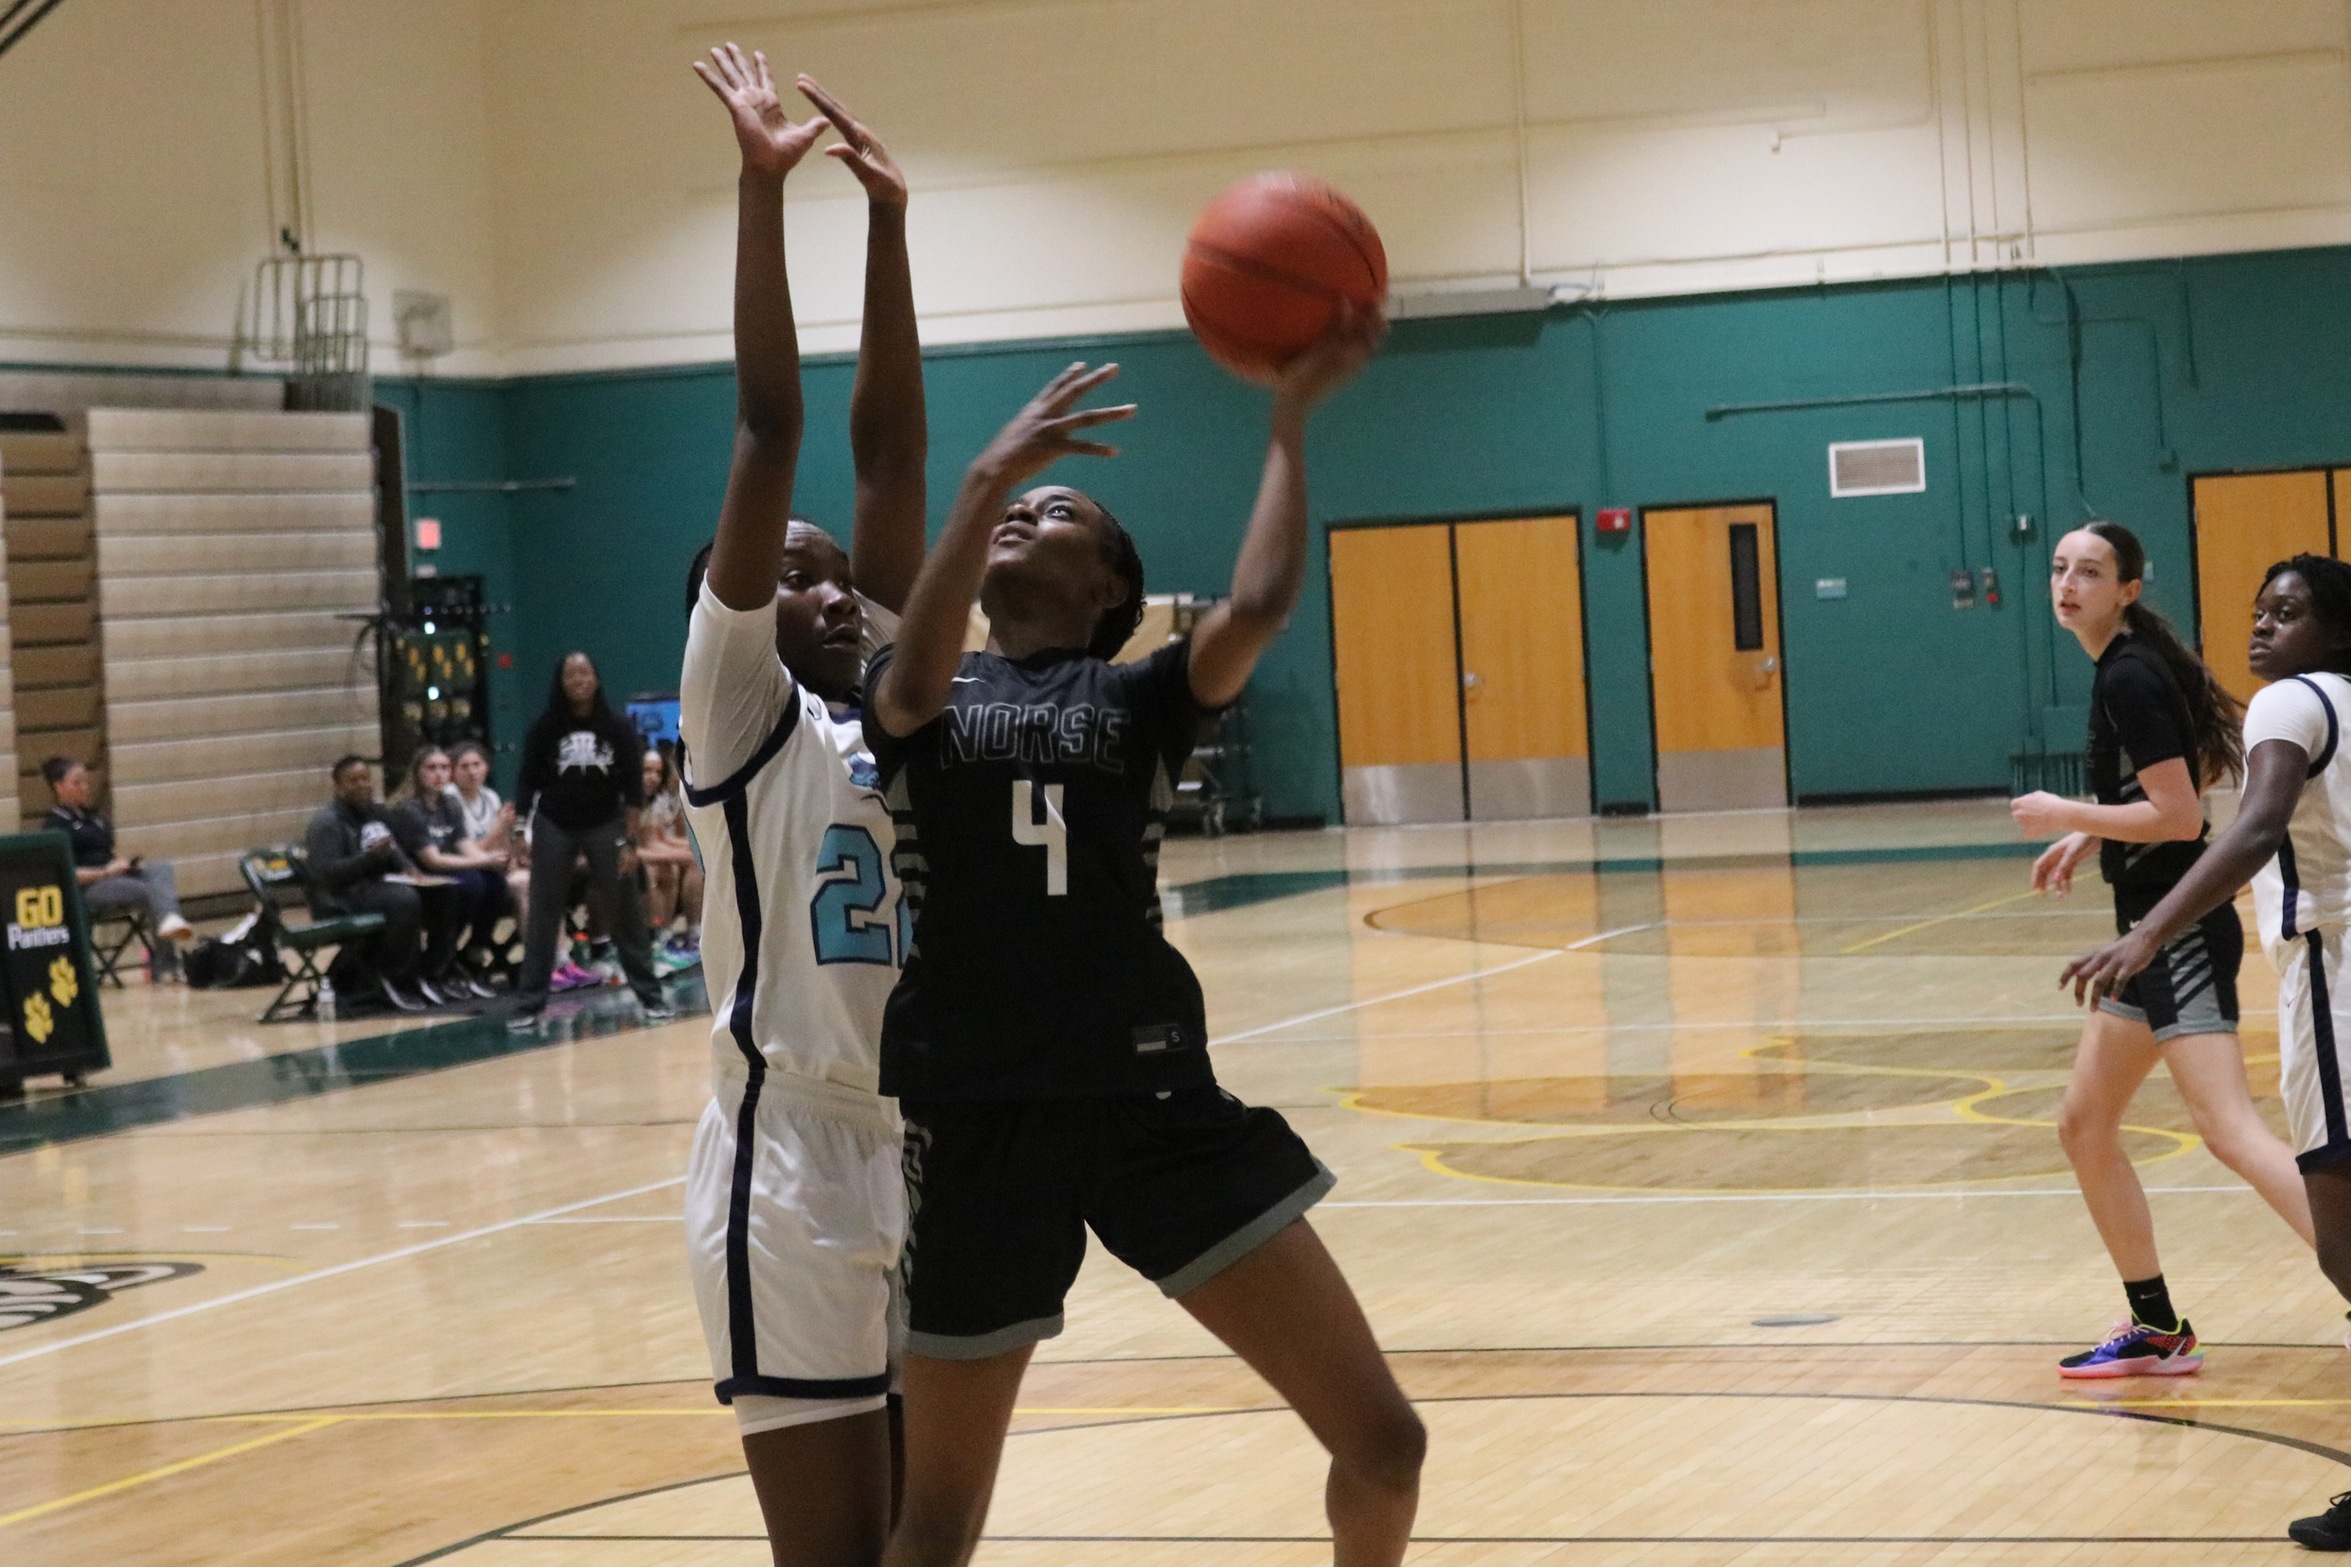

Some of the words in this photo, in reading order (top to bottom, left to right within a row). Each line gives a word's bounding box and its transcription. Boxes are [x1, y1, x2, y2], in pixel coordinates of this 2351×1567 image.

[939, 702, 1130, 774] NORSE
[1012, 779, 1068, 896] 4
[16, 885, 63, 929] GO
[810, 823, 913, 969] 2
[1171, 1031, 1180, 1043] S
